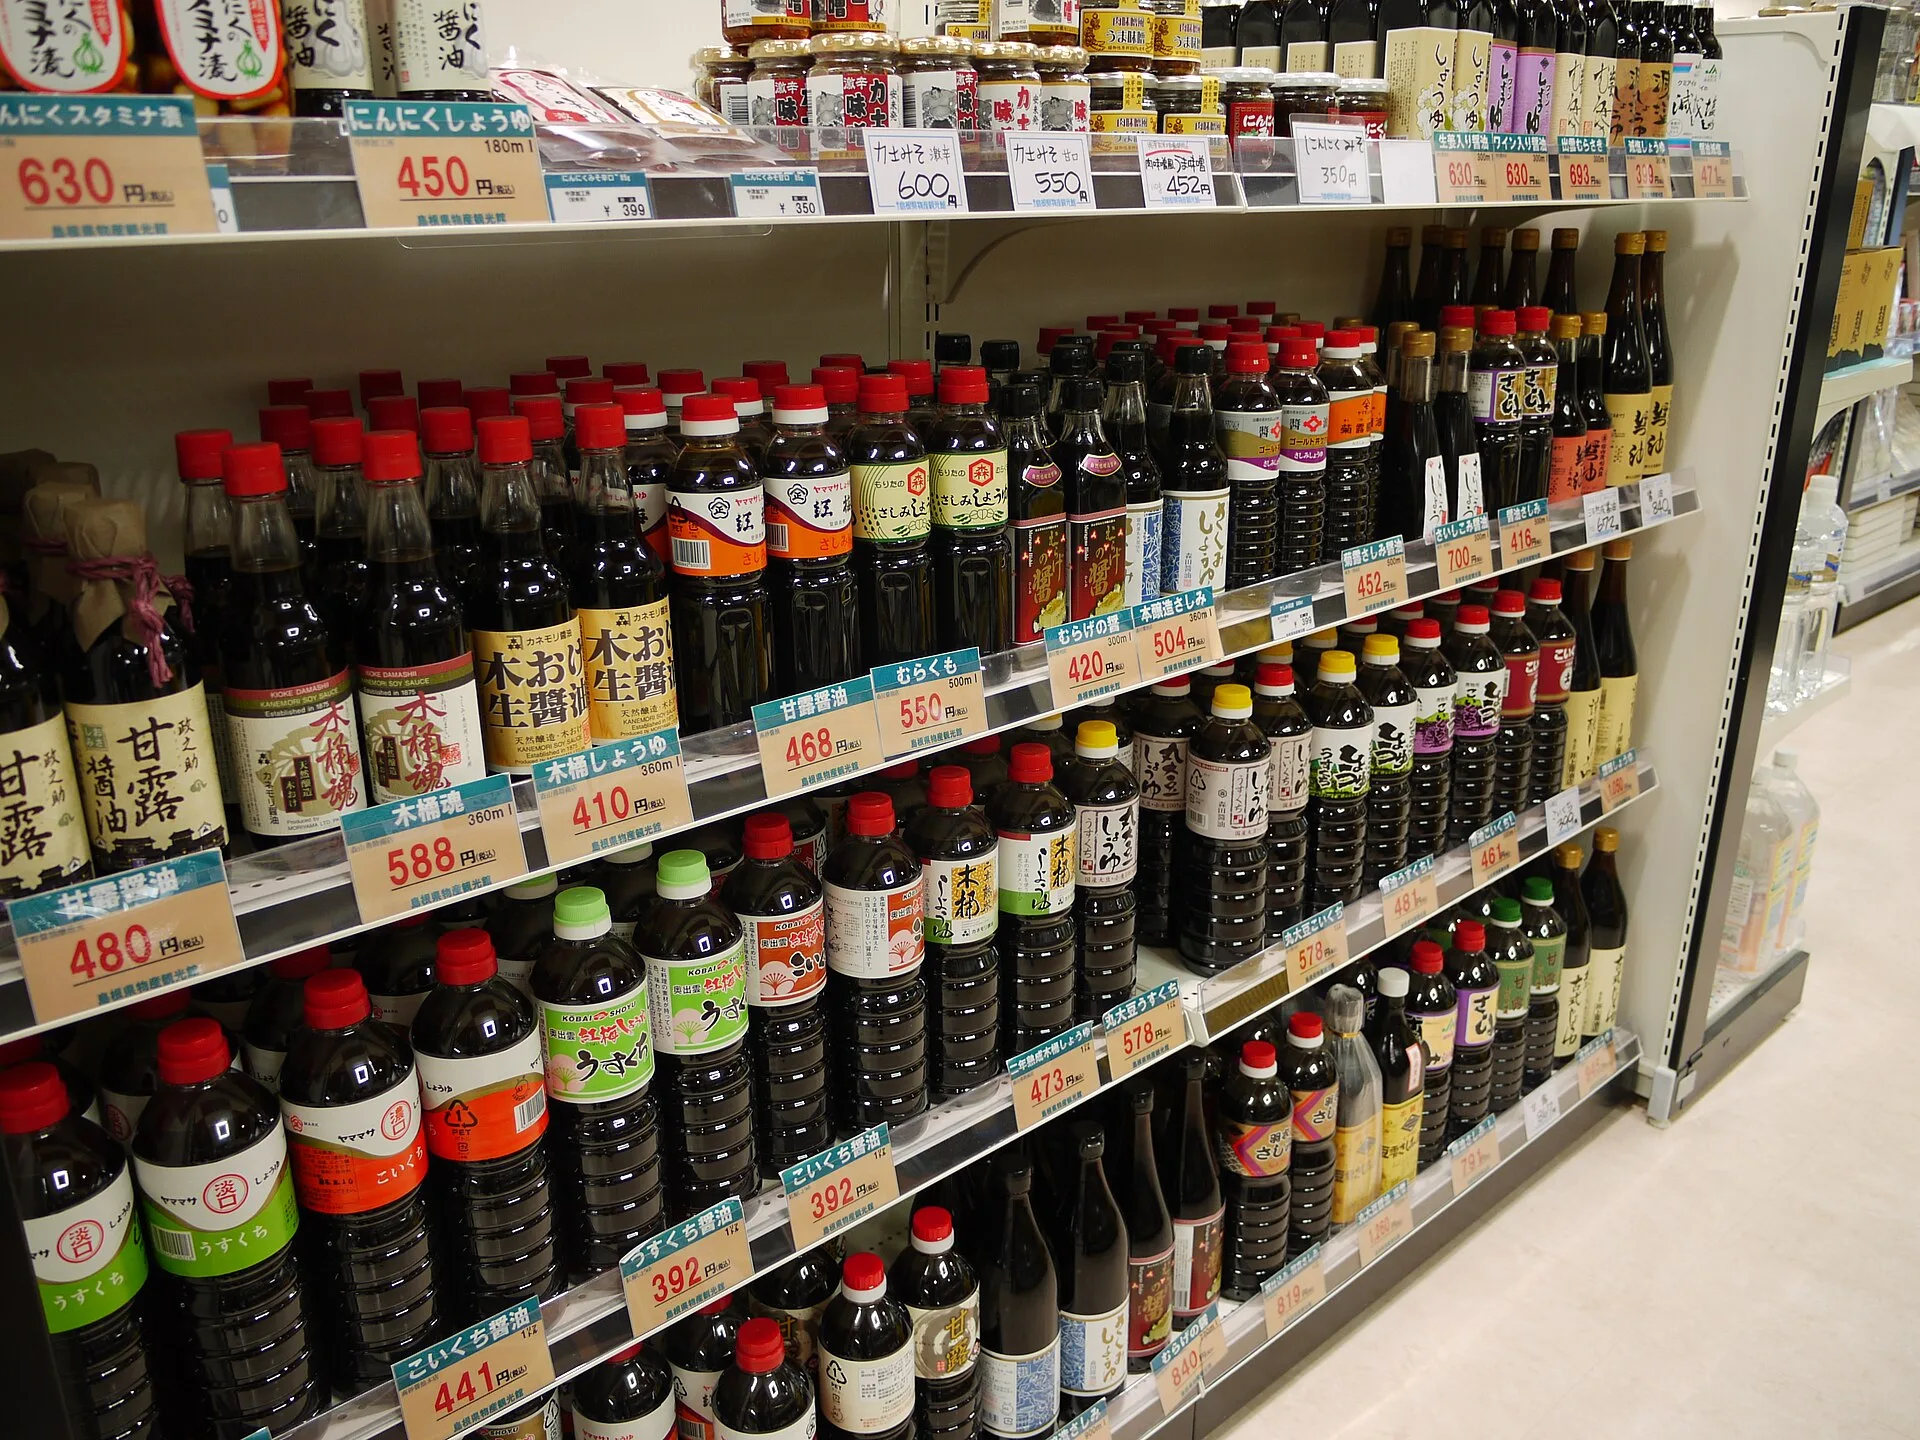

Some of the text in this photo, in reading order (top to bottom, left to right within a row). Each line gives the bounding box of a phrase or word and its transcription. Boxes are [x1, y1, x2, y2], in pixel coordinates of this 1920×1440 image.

[433, 9, 465, 71] 醤油
[774, 81, 799, 95] 激辛
[842, 77, 868, 91] 激辛
[348, 106, 532, 133] にんにくしょうゆ
[873, 141, 926, 165] 力士みそ
[1014, 143, 1058, 166] 力士みそ
[1493, 134, 1548, 152] ワイン入り醤油
[18, 156, 115, 205] 630
[397, 155, 470, 198] 450
[1448, 161, 1473, 187] 630
[1505, 162, 1529, 187] 630
[1569, 163, 1590, 187] 693
[1635, 164, 1654, 184] 399
[1700, 165, 1719, 181] 471
[622, 202, 646, 218] 399
[795, 201, 817, 215] 350
[1435, 513, 1488, 542] さいしこみ醤油
[1510, 528, 1533, 551] 416
[1447, 546, 1470, 573] 700
[1357, 571, 1382, 598] 452
[1139, 591, 1207, 623] 本醸造さしみ
[1301, 616, 1312, 626] 399
[526, 628, 573, 648] カネモリ醤油
[1057, 616, 1121, 646] むらげの醤
[1153, 625, 1186, 658] 504
[382, 669, 418, 679] DAMASHII
[480, 636, 585, 691] 木おけ
[896, 656, 958, 685] むらくも
[1068, 650, 1103, 683] 420
[270, 681, 331, 698] KIOKE DAMASHII
[488, 677, 588, 729] 生醤油
[779, 685, 849, 722] 甘露醤油
[264, 706, 307, 718] Established
[899, 692, 943, 729] 550
[309, 700, 358, 812] 木桶魂
[394, 690, 452, 793] 木桶魂
[517, 742, 554, 753] KANEMORI
[785, 726, 833, 767] 468
[116, 716, 185, 832] 甘露
[546, 734, 668, 786] 木桶しょうゆ
[1141, 743, 1161, 799] しょうゆ
[86, 753, 129, 836] 醤油
[392, 788, 466, 829] 木桶魂
[572, 785, 629, 831] 410
[1234, 774, 1244, 814] うすくち
[467, 808, 513, 827] 360ml
[1083, 817, 1093, 859] うすくち
[1099, 815, 1121, 873] しょうゆ
[386, 835, 456, 887] 588
[1051, 833, 1071, 889] 木桶
[1480, 843, 1503, 869] 461
[954, 863, 980, 921] 木桶
[1031, 847, 1052, 911] しょうゆ
[932, 874, 954, 941] しょうゆ
[1393, 888, 1419, 917] 481
[1283, 904, 1345, 947] 丸大豆こいくち
[69, 923, 153, 981] 480
[760, 938, 788, 949] 奥出雲
[1298, 941, 1324, 970] 578
[672, 983, 702, 995] 奥出雲
[1104, 981, 1179, 1030] 丸大豆うすくち
[609, 1001, 637, 1017] SHOYU
[549, 1028, 576, 1041] 奥出雲
[1009, 1026, 1092, 1076] 二年熟成木桶しょうゆ
[1122, 1021, 1154, 1055] 578
[1030, 1068, 1065, 1103] 473
[337, 1127, 376, 1144] ヤママサ
[451, 1128, 472, 1136] PET
[254, 1160, 281, 1186] しょうゆ
[376, 1145, 424, 1186] こいくち
[791, 1129, 882, 1187] こいくち醤油
[159, 1195, 198, 1207] ヤママサ
[213, 1179, 238, 1210] 淡口
[810, 1176, 855, 1220] 392
[69, 1225, 93, 1259] 淡口
[200, 1224, 269, 1257] うすくち
[628, 1203, 734, 1270] うすくち醤油
[53, 1270, 125, 1313] うすくち
[651, 1255, 703, 1304] 392
[408, 1305, 531, 1381] こいくち醤油
[945, 1309, 971, 1376] 甘露
[1160, 1313, 1211, 1366] むらげの醤
[1171, 1349, 1199, 1388] 840
[434, 1360, 495, 1414] 441
[489, 1425, 519, 1438] SHOYU
